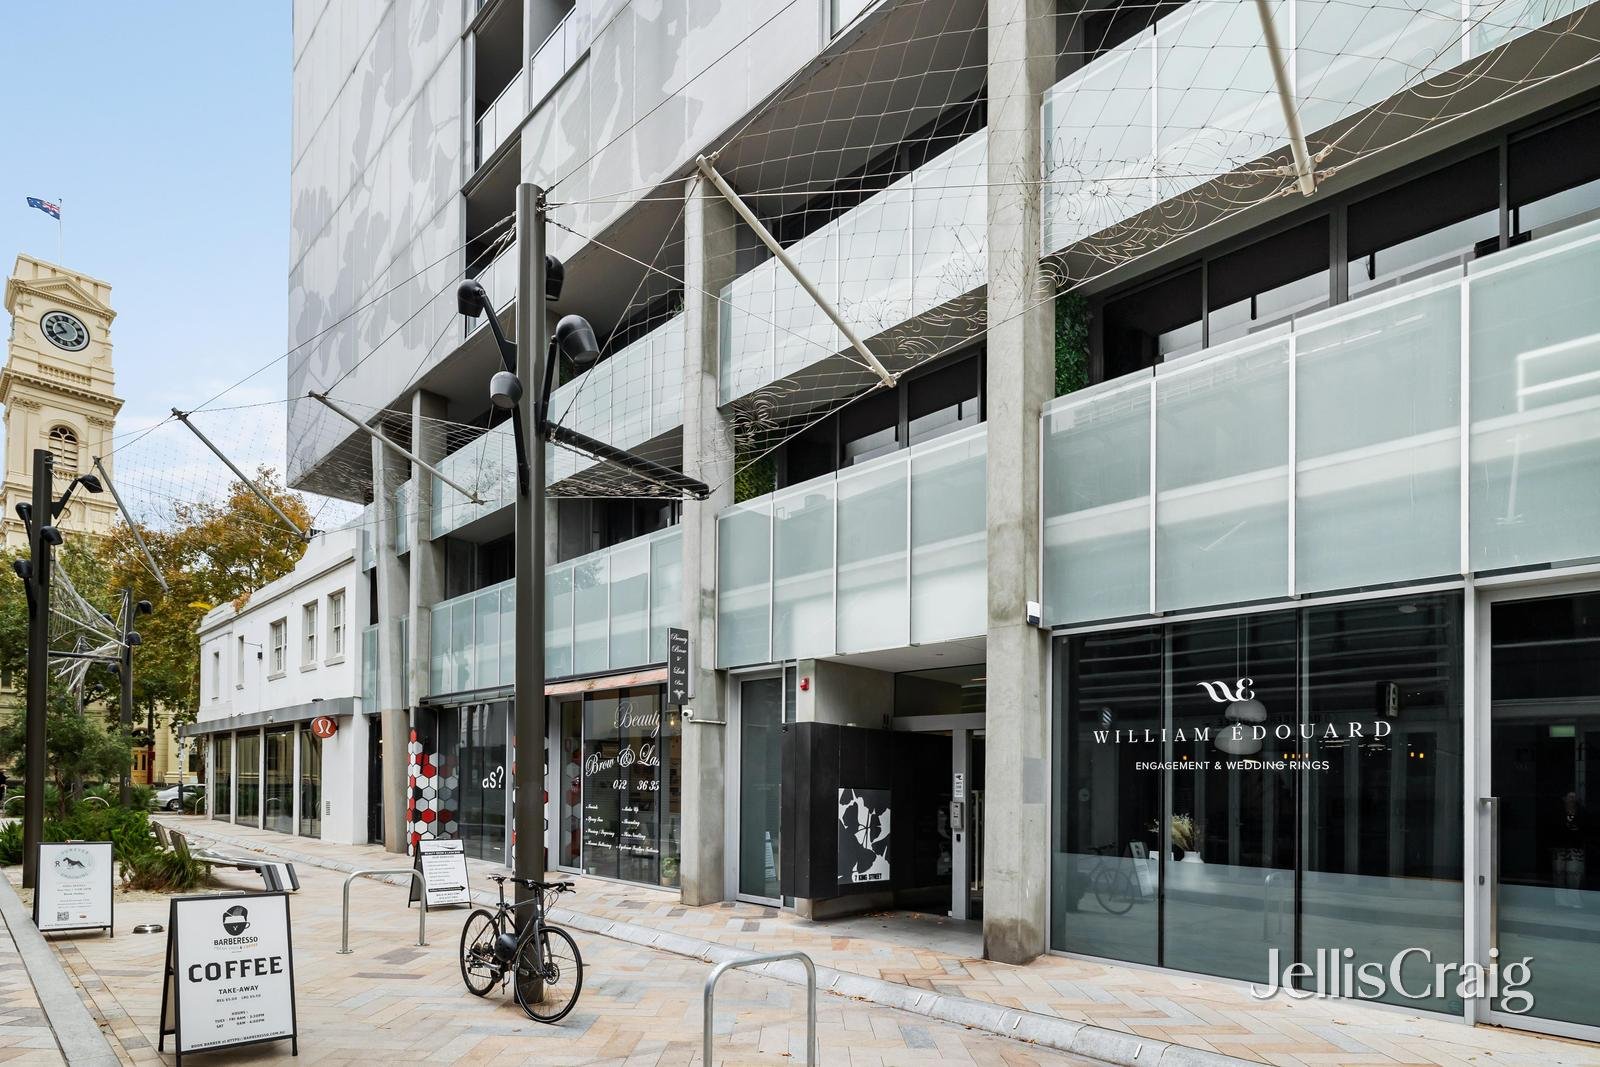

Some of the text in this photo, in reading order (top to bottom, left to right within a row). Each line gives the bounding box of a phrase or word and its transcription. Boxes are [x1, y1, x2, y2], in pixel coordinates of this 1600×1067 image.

[614, 701, 660, 738] Beauty
[1094, 720, 1392, 744] WILLIAM ÉDOUARD
[586, 752, 614, 776] Brow
[1135, 760, 1330, 770] ENGAGEMENT & WEDDING RINGS
[214, 936, 258, 946] BARBERESSO
[188, 956, 283, 983] COFFEE
[219, 985, 259, 995] TAKE-AWAY
